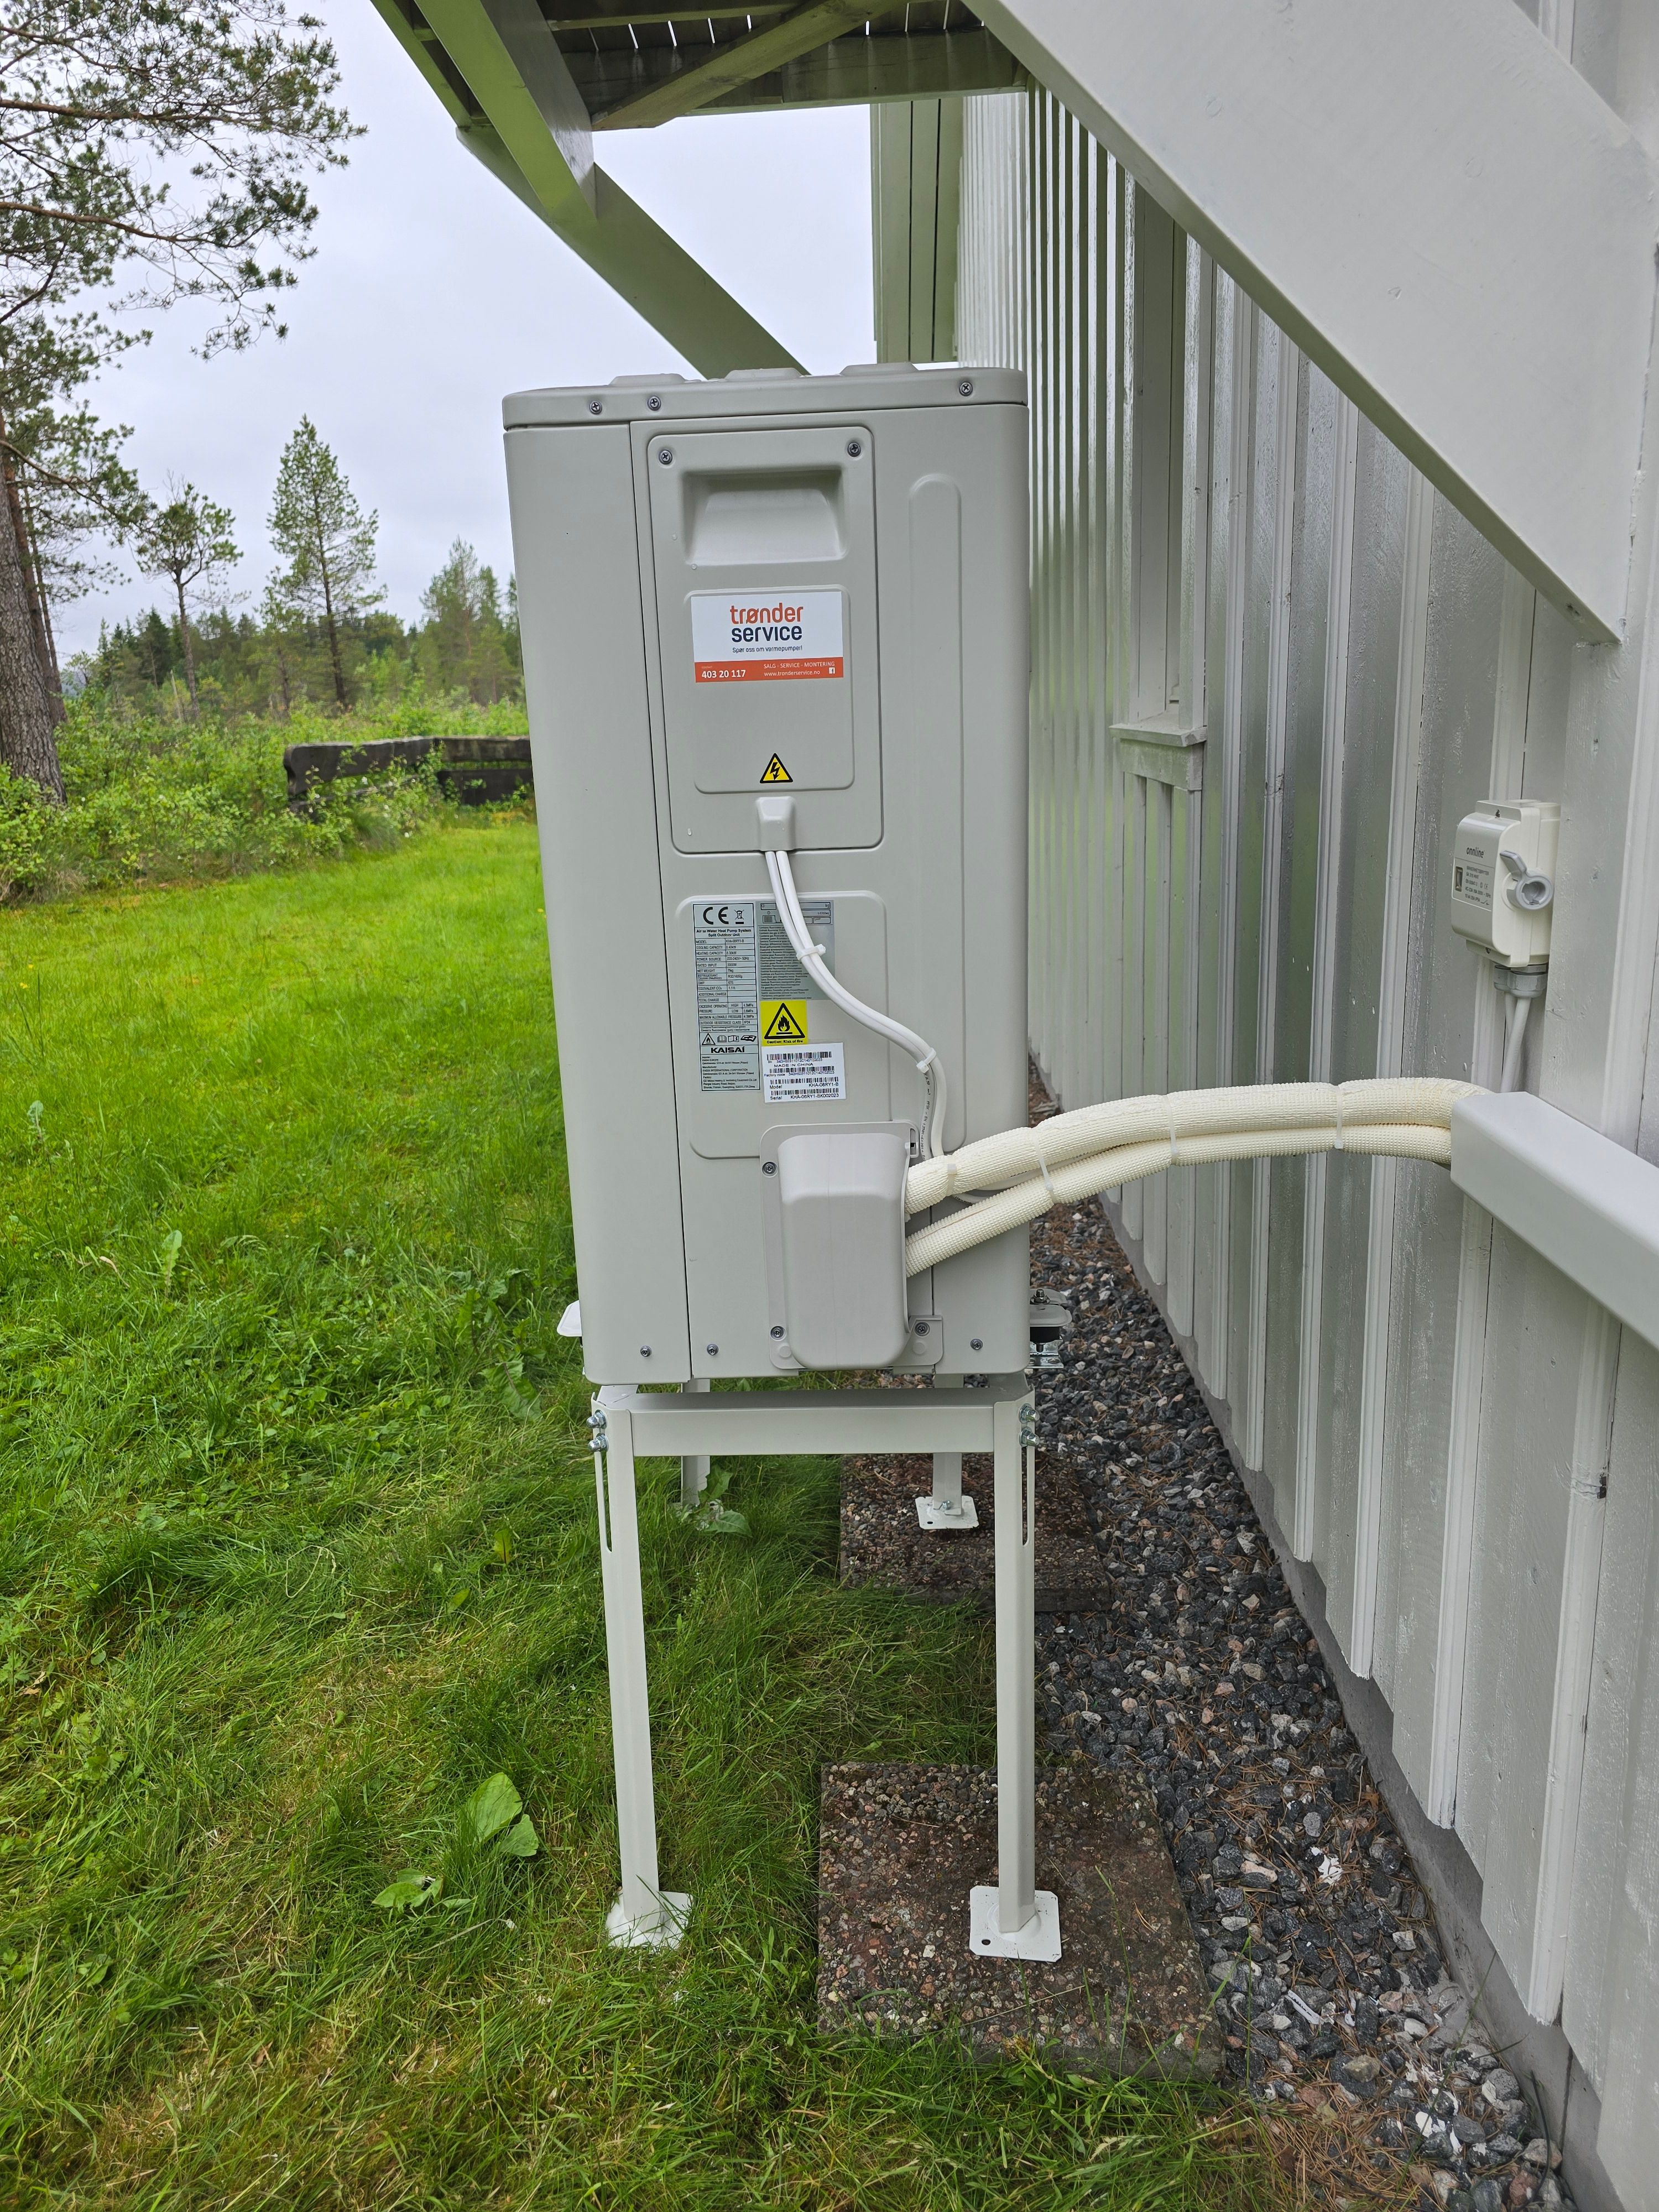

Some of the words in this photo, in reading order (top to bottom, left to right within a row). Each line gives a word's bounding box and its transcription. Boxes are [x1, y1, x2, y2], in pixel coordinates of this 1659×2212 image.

[730, 602, 804, 624] trønder
[732, 625, 802, 643] service
[1467, 847, 1484, 858] onnline
